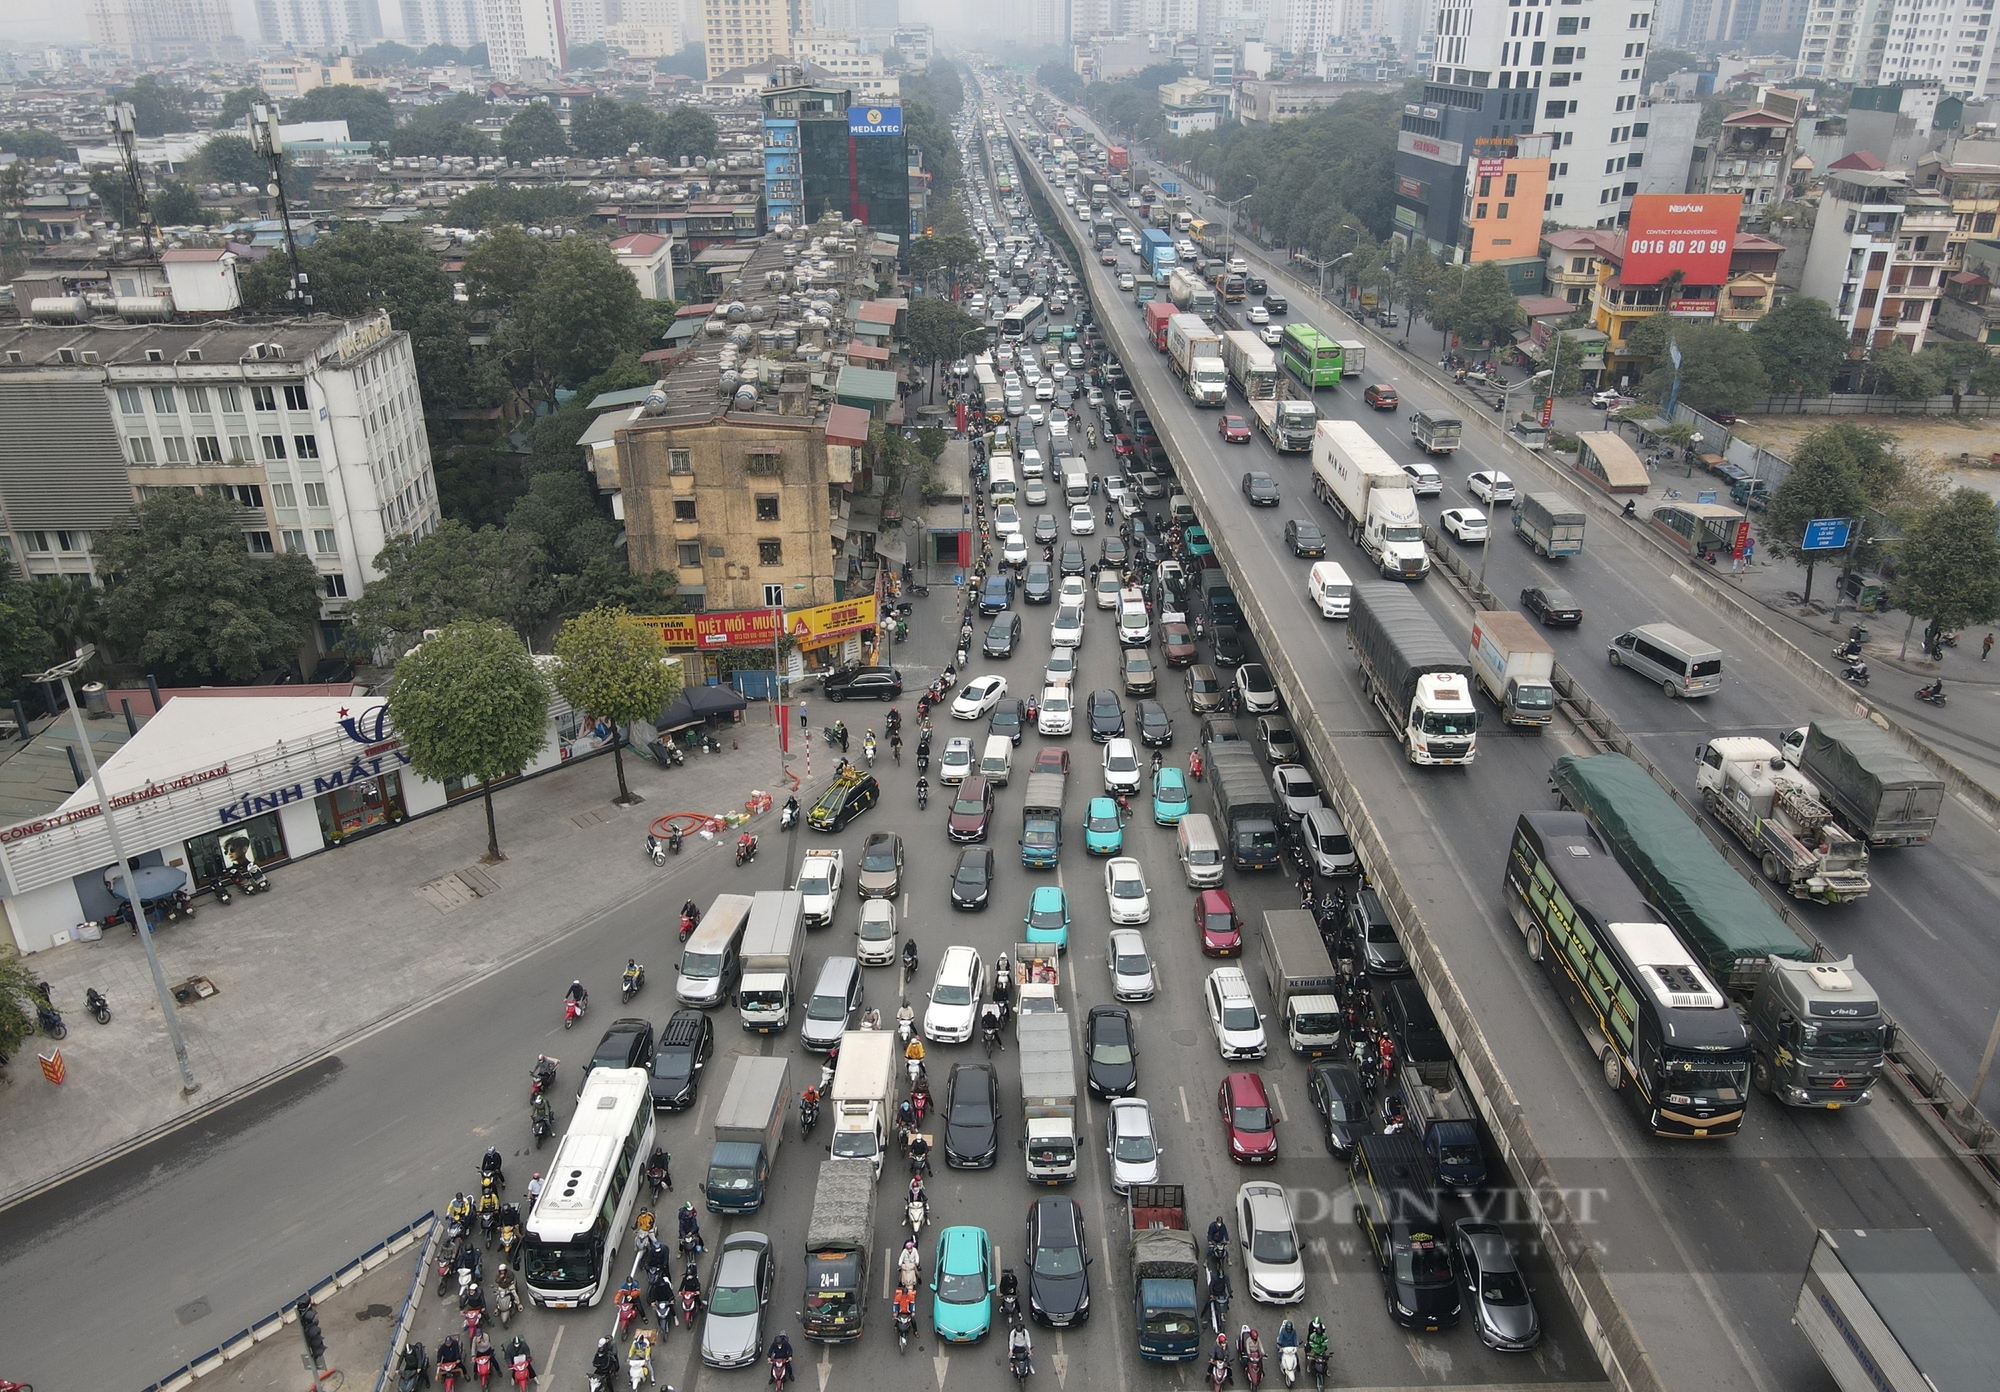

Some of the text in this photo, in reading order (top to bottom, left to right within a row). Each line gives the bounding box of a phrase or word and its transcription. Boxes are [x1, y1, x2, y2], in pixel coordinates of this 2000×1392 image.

[850, 125, 899, 133] MEDLATEC
[1631, 240, 1726, 254] 0916 80 20 99
[725, 562, 750, 580] C3
[660, 619, 684, 629] THẤM
[698, 618, 721, 636] DIỆT
[725, 614, 745, 633] MỐI
[793, 622, 809, 636] Sika
[663, 628, 694, 641] DTH
[219, 756, 382, 825] KÍNH MẮT
[0, 821, 45, 843] CÔNG
[46, 815, 63, 829] TY
[66, 804, 102, 822] TNHH
[138, 783, 165, 800] MẮT
[169, 775, 194, 791] VIỆT
[198, 764, 228, 781] NAM
[820, 1273, 839, 1287] 24-H
[1820, 1293, 1836, 1318] CÔNG
[1836, 1317, 1844, 1328] TY
[1844, 1326, 1860, 1352] TNHH
